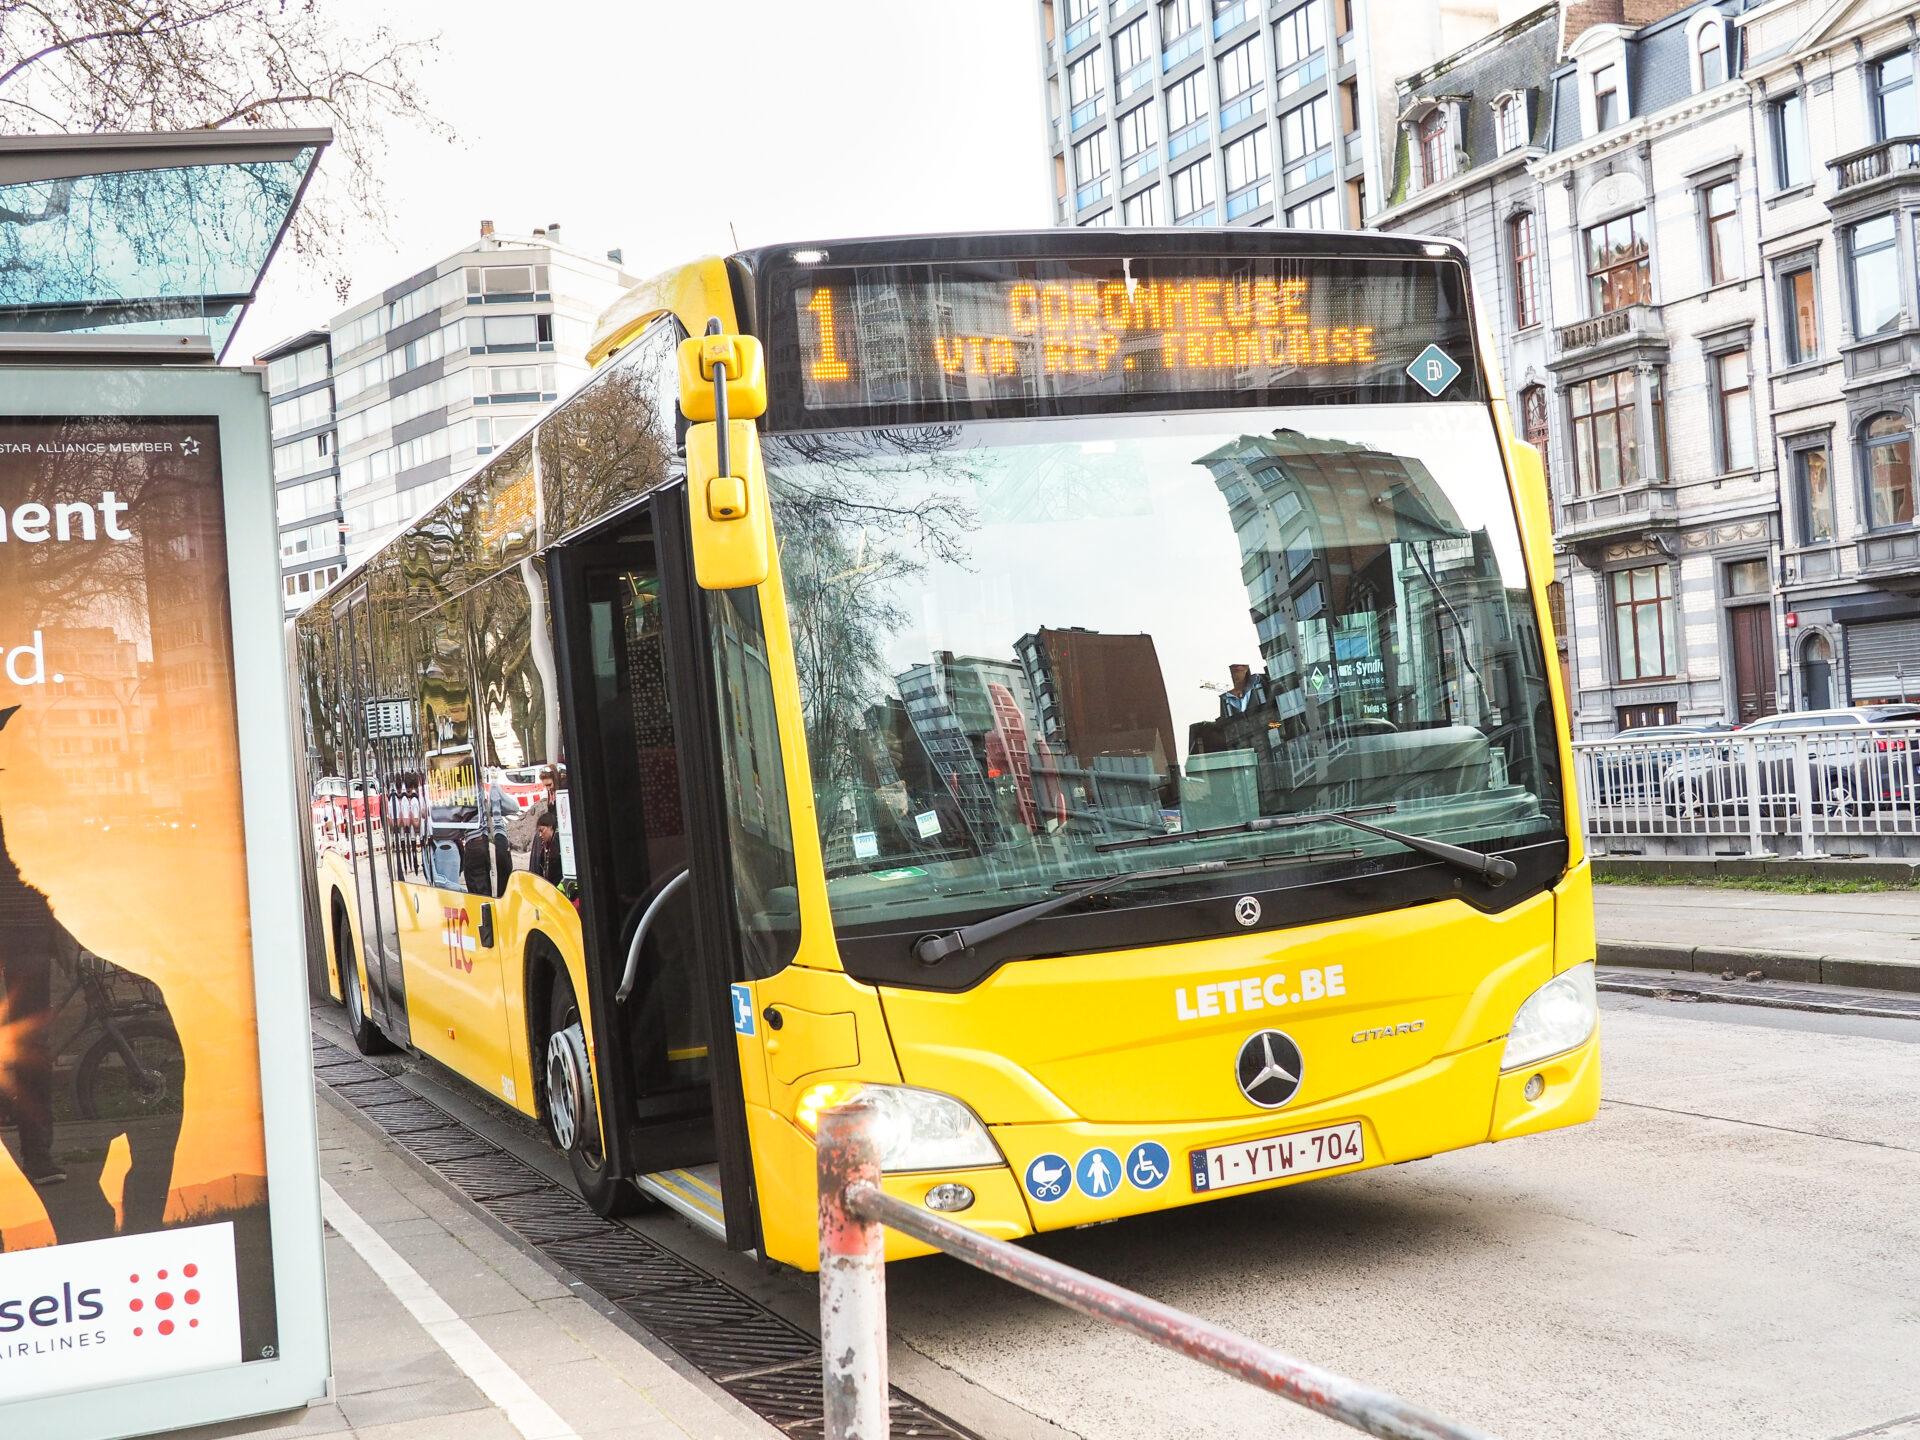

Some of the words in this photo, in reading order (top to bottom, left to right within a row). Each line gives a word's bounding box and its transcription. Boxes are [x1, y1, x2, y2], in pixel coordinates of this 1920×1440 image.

[808, 287, 849, 380] 1
[934, 335, 1015, 374] VIA
[1044, 333, 1136, 371] REP.
[36, 443, 106, 453] ALLIANCE
[109, 442, 173, 452] MEMBER
[0, 630, 65, 685] d.
[444, 906, 473, 974] TEC
[1175, 964, 1346, 1021] LETEC.BE
[1351, 1019, 1425, 1044] CITARO
[1195, 1172, 1207, 1187] B
[1214, 1129, 1359, 1181] 1-YTW-704
[0, 1330, 106, 1359] IRLINES
